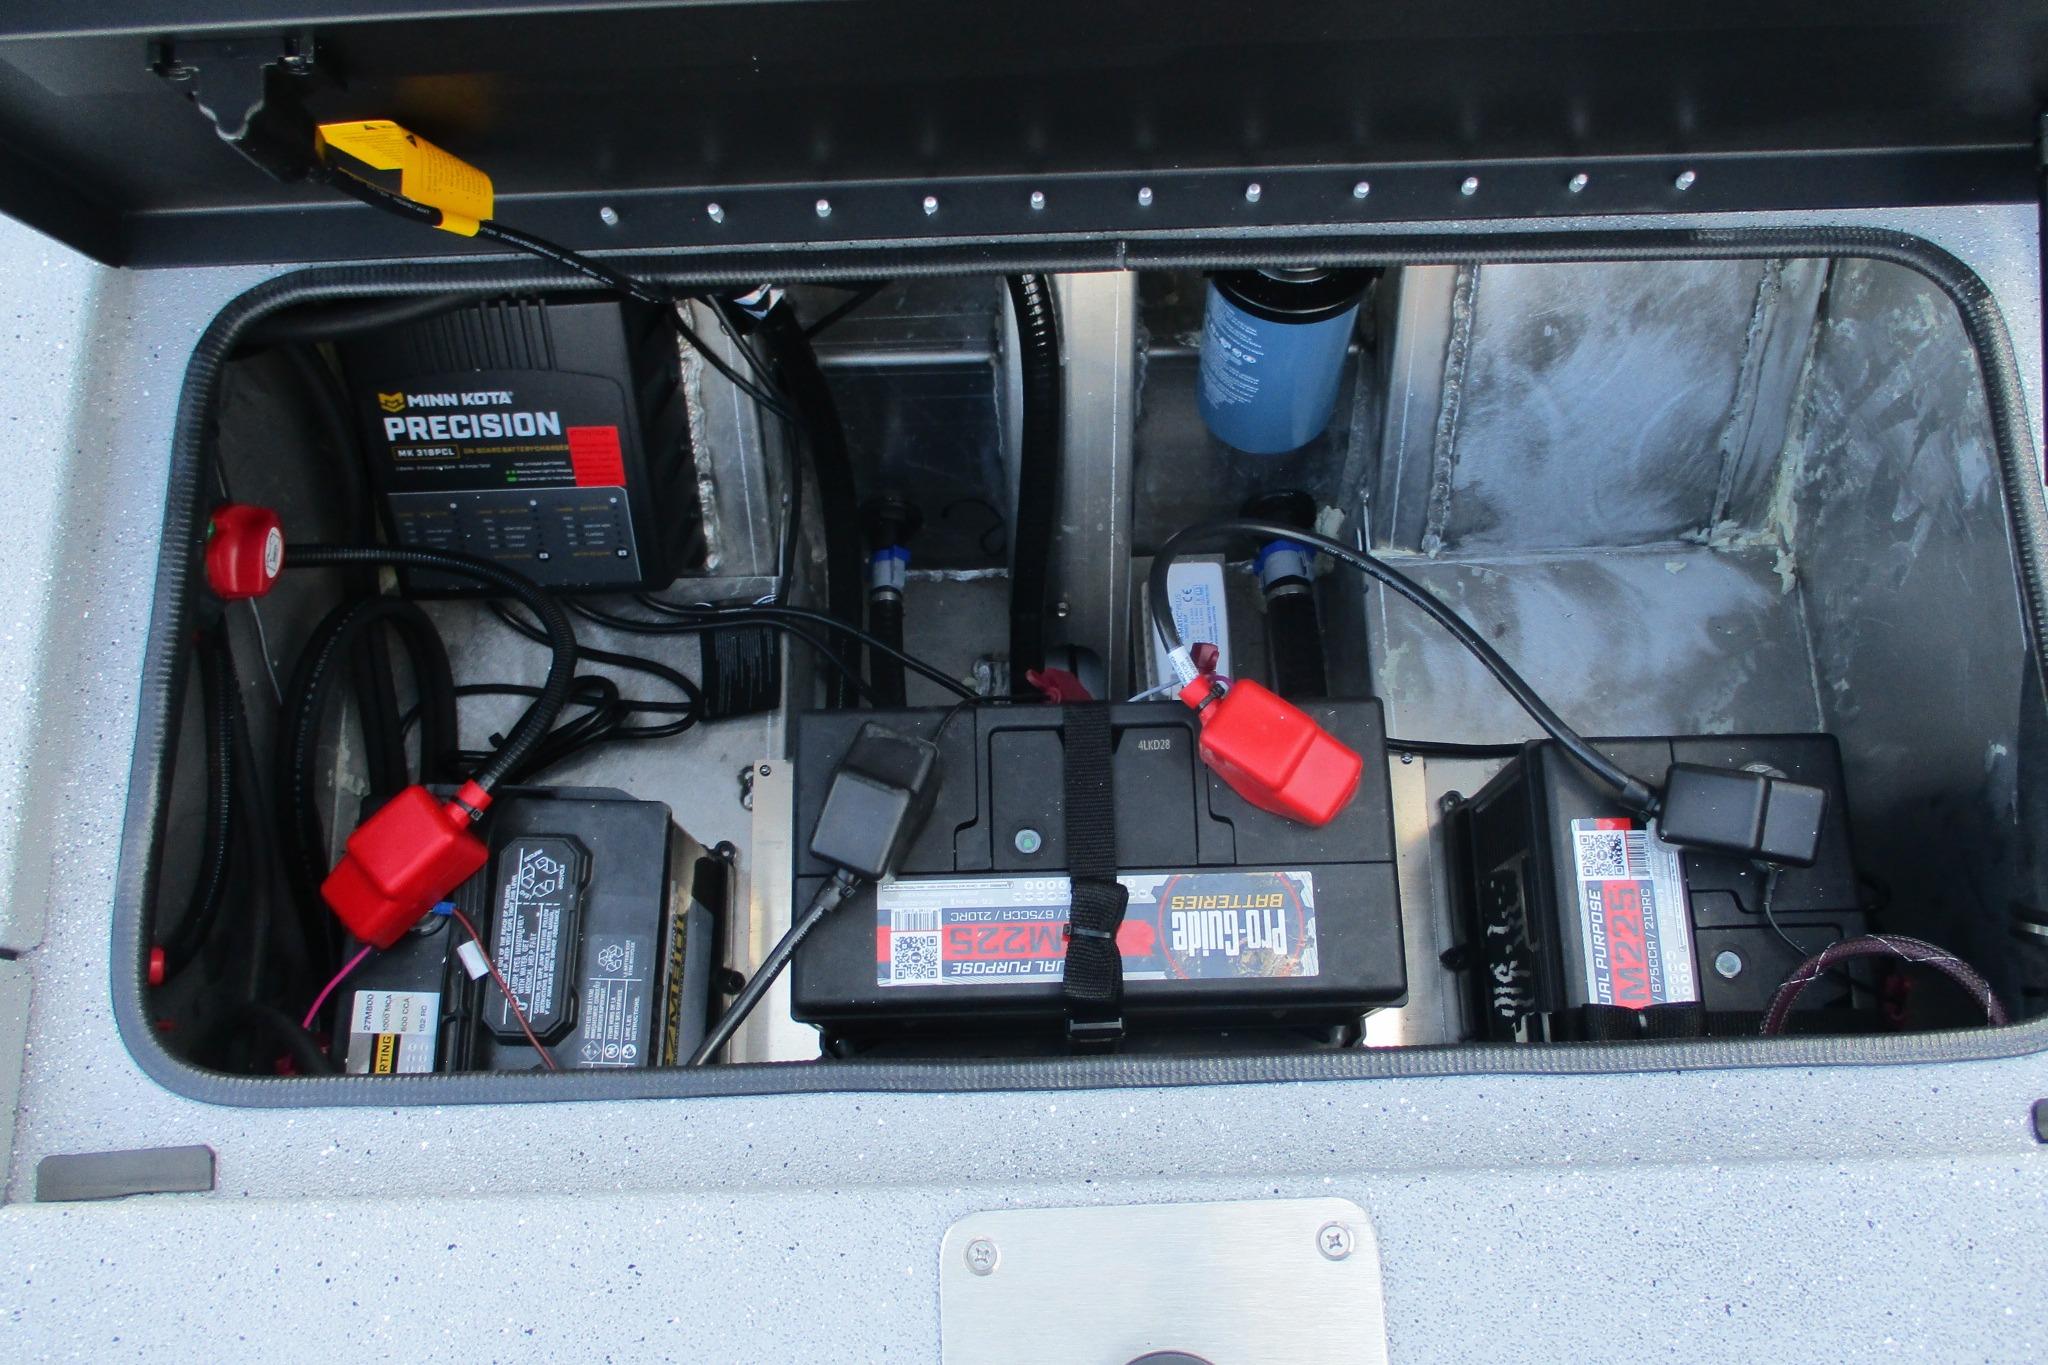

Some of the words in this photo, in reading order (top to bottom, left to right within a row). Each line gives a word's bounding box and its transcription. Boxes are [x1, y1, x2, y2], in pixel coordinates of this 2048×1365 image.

[407, 392, 458, 408] MINN
[461, 391, 511, 407] KOTA
[384, 411, 562, 442] PRECISION
[397, 448, 414, 457] MK
[1137, 739, 1171, 751] 4LKD28
[1171, 894, 1284, 909] BATTERIES
[1641, 888, 1655, 929] 210RC
[950, 911, 992, 923] 210RC
[514, 915, 524, 954] IMMEDIATELY
[950, 925, 1062, 954] M225
[1171, 909, 1287, 956] Pro-Guide
[1589, 889, 1607, 969] PURPOSE
[1608, 887, 1647, 1000] M225
[512, 957, 520, 972] EYES
[951, 961, 1032, 975] PURPOSE
[525, 968, 533, 994] MEDICAL
[363, 993, 374, 1031] 27M800
[402, 997, 410, 1014] CCA
[420, 1005, 427, 1016] RC
